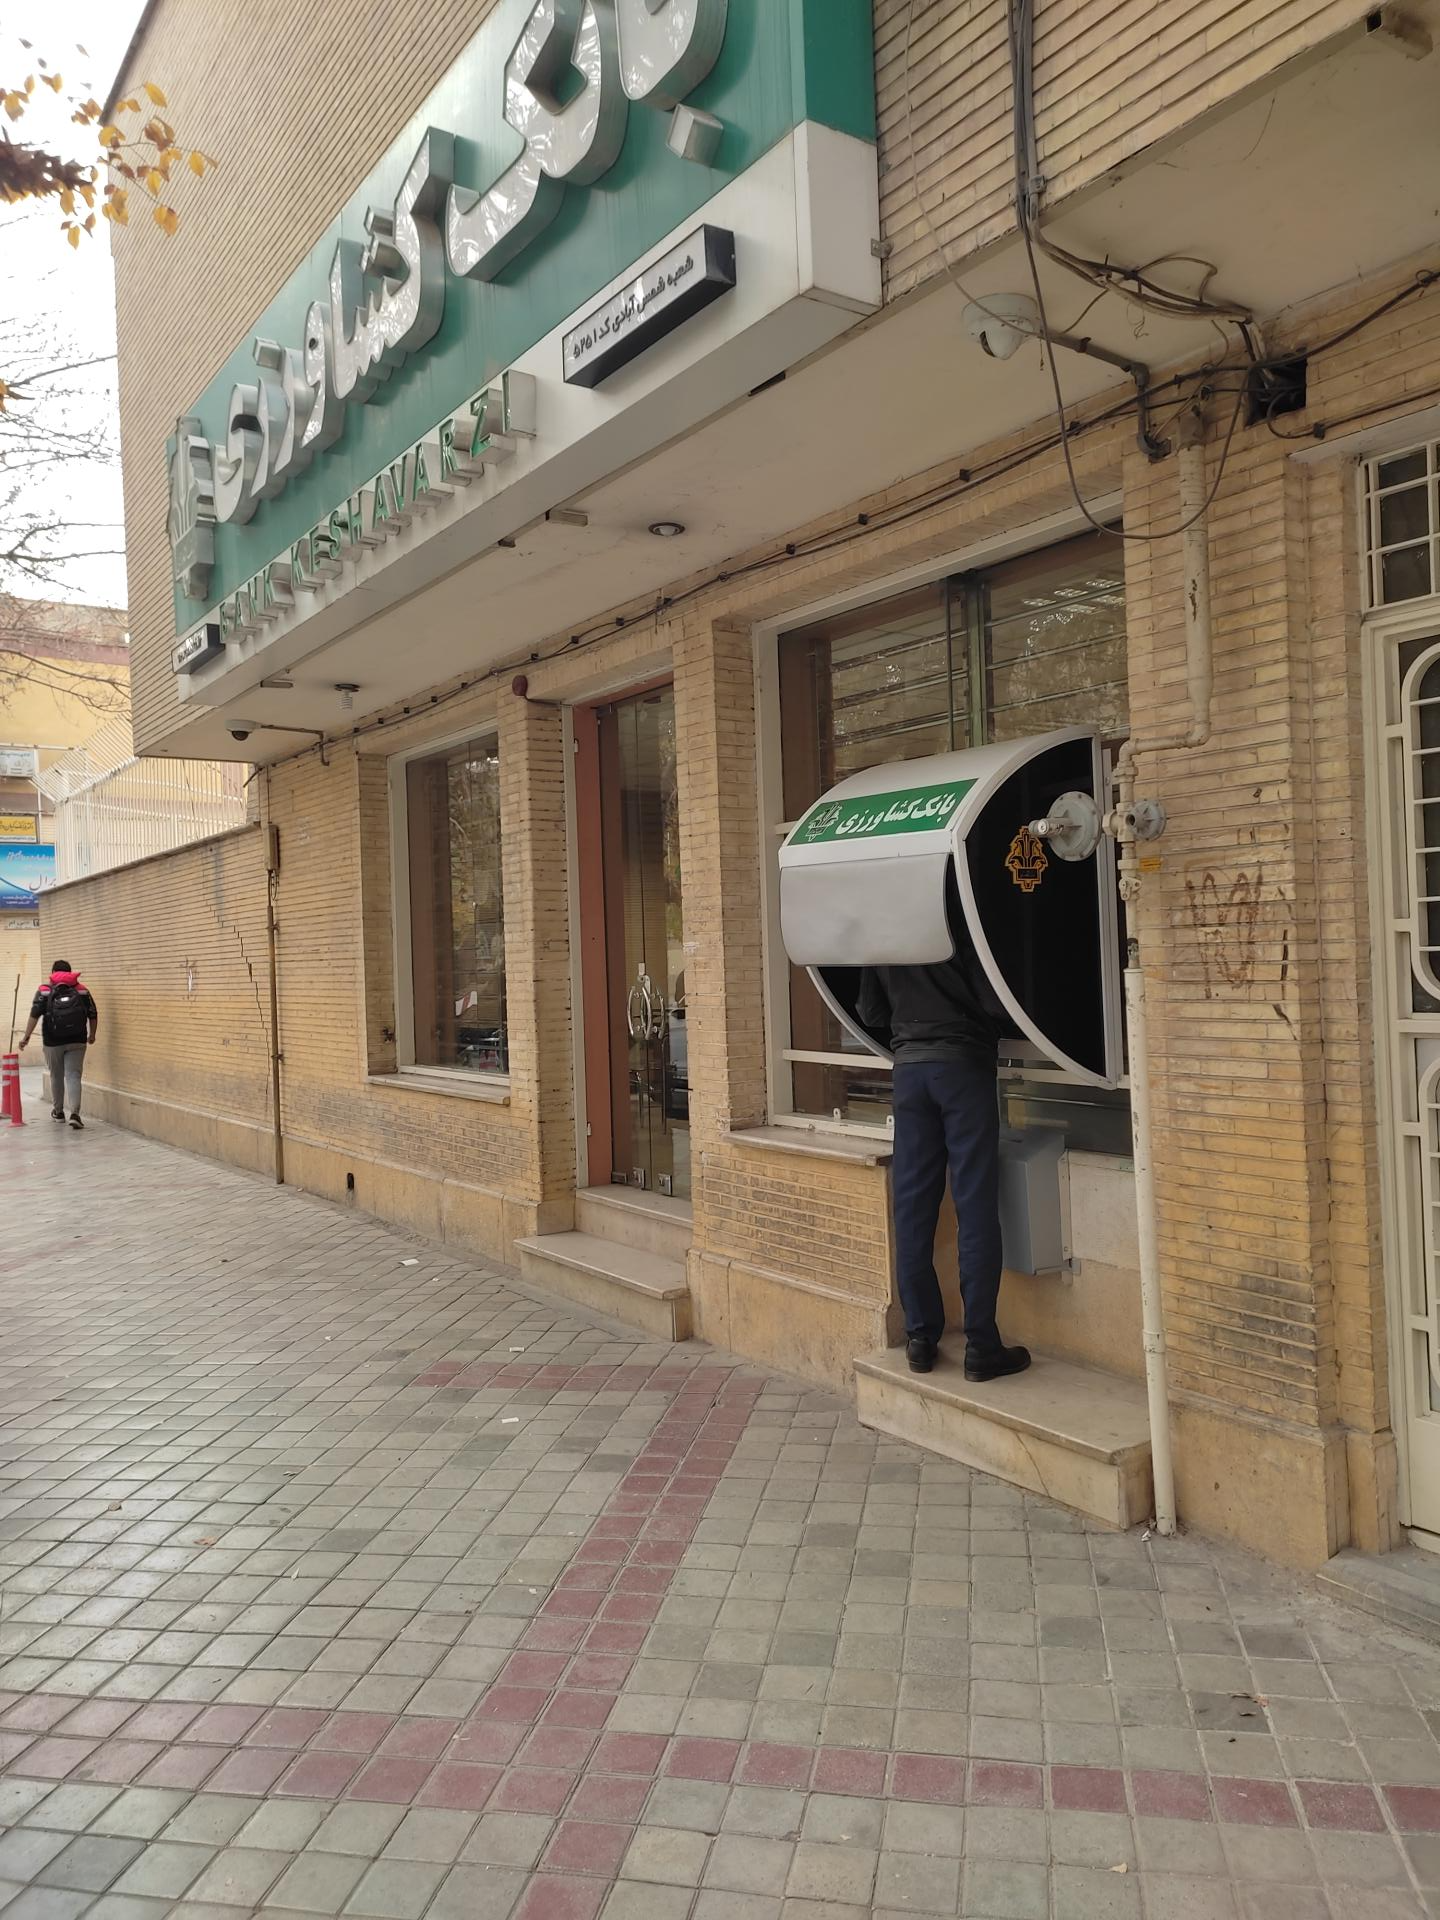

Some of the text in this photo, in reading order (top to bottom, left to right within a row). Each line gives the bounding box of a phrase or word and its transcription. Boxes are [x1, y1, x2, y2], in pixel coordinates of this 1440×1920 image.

[213, 0, 728, 524] بنک کشاورزی
[667, 256, 694, 286] شعبه
[612, 294, 636, 333] آبادی
[636, 276, 666, 314] شمس
[598, 315, 612, 340] کد
[219, 369, 532, 643] BANK KESHAVARZI
[835, 792, 956, 835] بانک کشاورزی
